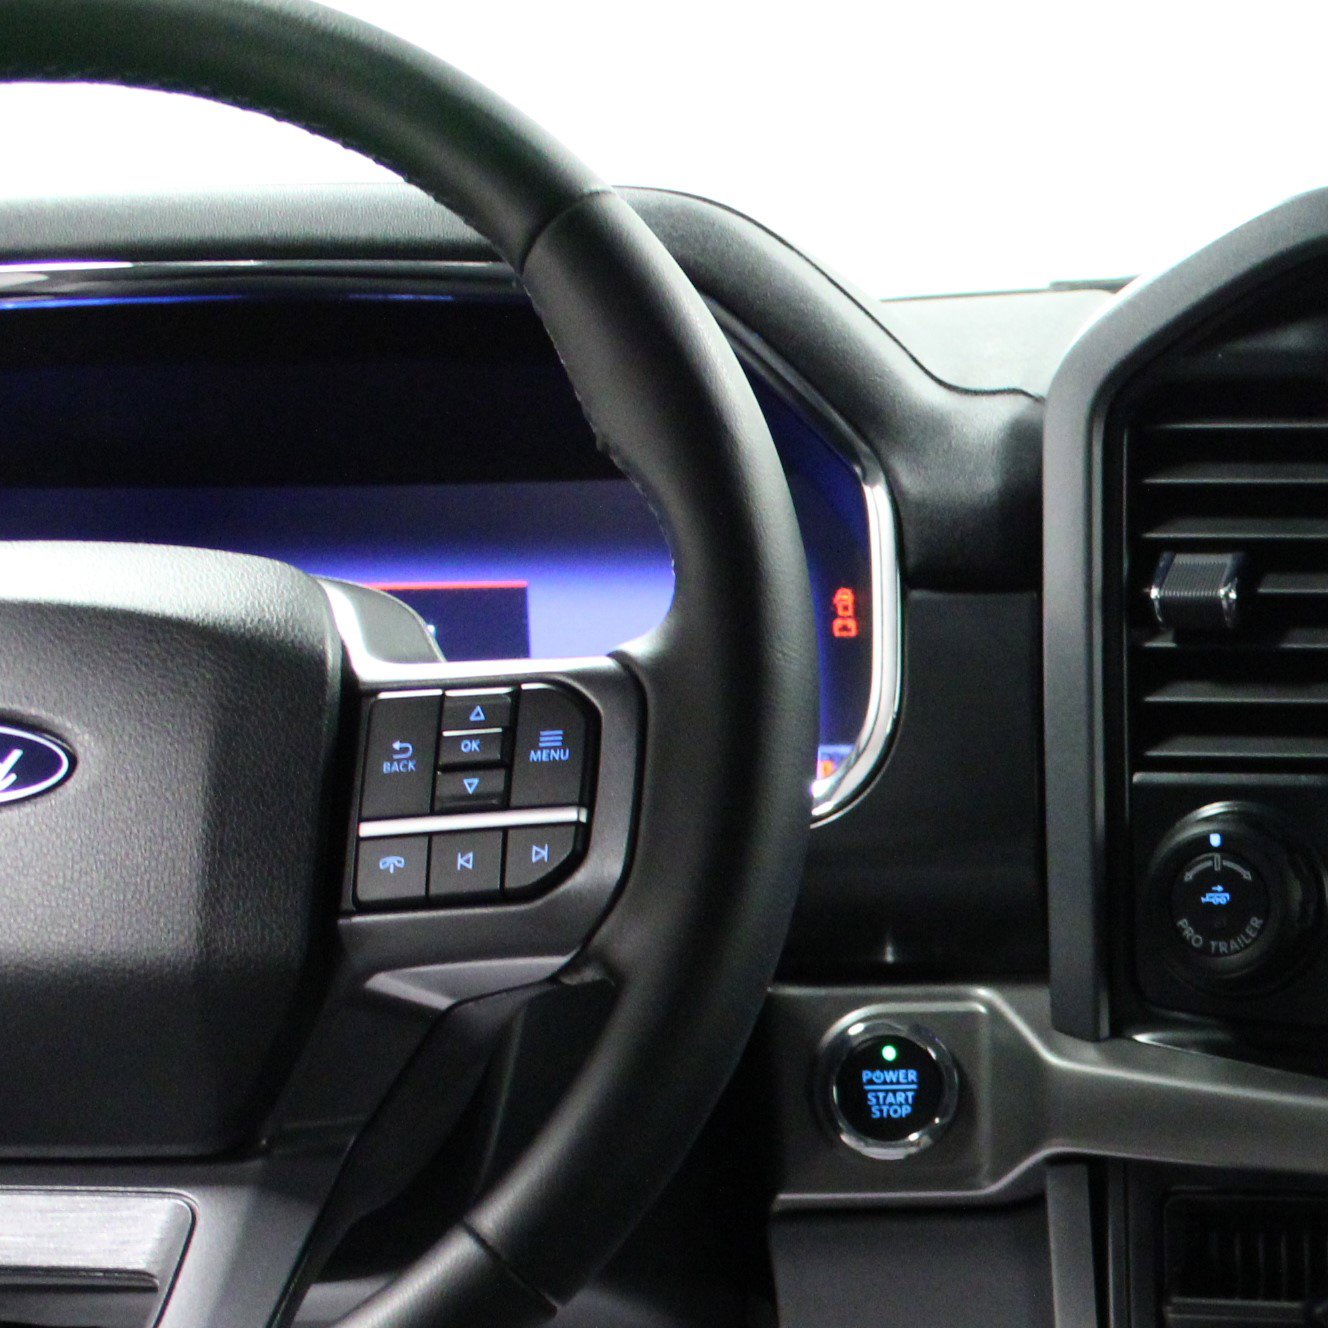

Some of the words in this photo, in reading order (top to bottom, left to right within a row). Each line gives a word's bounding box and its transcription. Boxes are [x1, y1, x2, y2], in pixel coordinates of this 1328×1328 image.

[460, 739, 480, 753] OK
[529, 748, 570, 762] MENU
[382, 759, 416, 774] BACK
[1177, 918, 1203, 948] PRO
[1210, 916, 1263, 953] TRAILER
[861, 1069, 918, 1084] POWER
[868, 1091, 914, 1105] START
[870, 1104, 911, 1118] STOP
